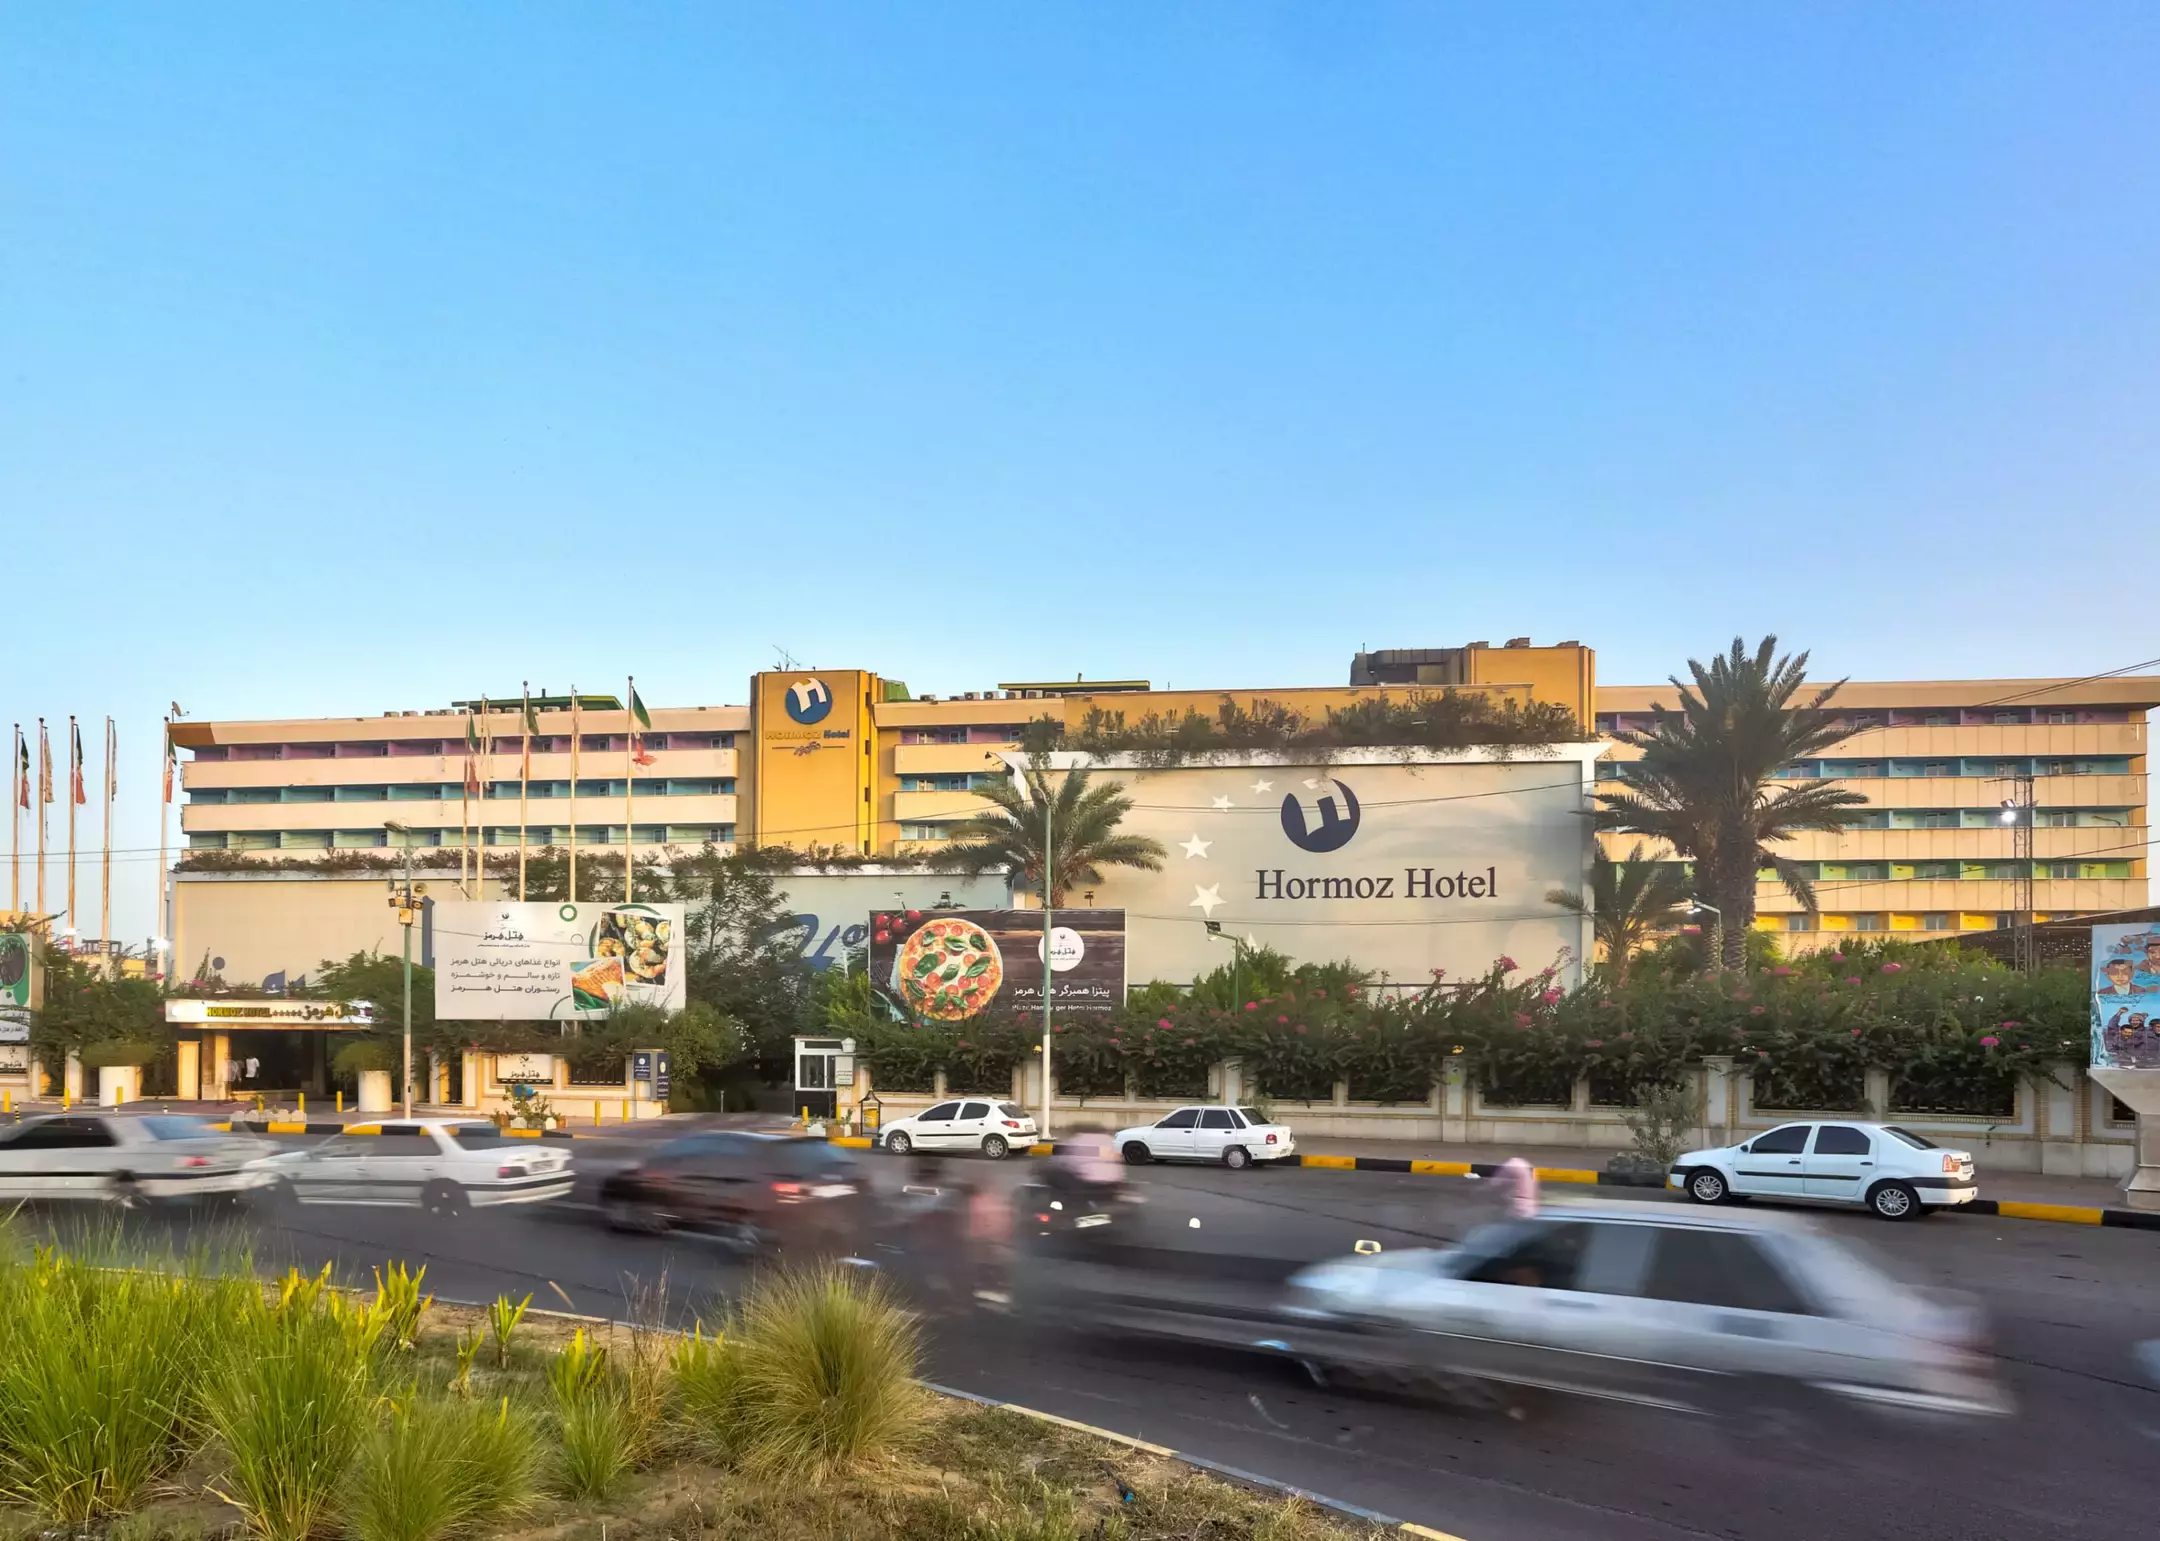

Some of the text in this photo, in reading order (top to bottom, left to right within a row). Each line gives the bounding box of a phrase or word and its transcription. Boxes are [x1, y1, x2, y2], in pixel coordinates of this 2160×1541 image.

[1255, 866, 1498, 900] Hormoz Hotel
[483, 930, 524, 941] هتل هرمز
[450, 958, 469, 966] هرمز
[470, 958, 488, 967] هتل
[514, 958, 542, 967] غذاهای
[543, 959, 561, 968] انواع
[547, 972, 560, 981] تازه
[450, 985, 560, 994] رستوران هتل هرمز
[1014, 984, 1110, 998] پیتزا همبرگر هل هرمز
[302, 1004, 334, 1021] هرمز
[510, 1069, 541, 1078] هتل هرمز
